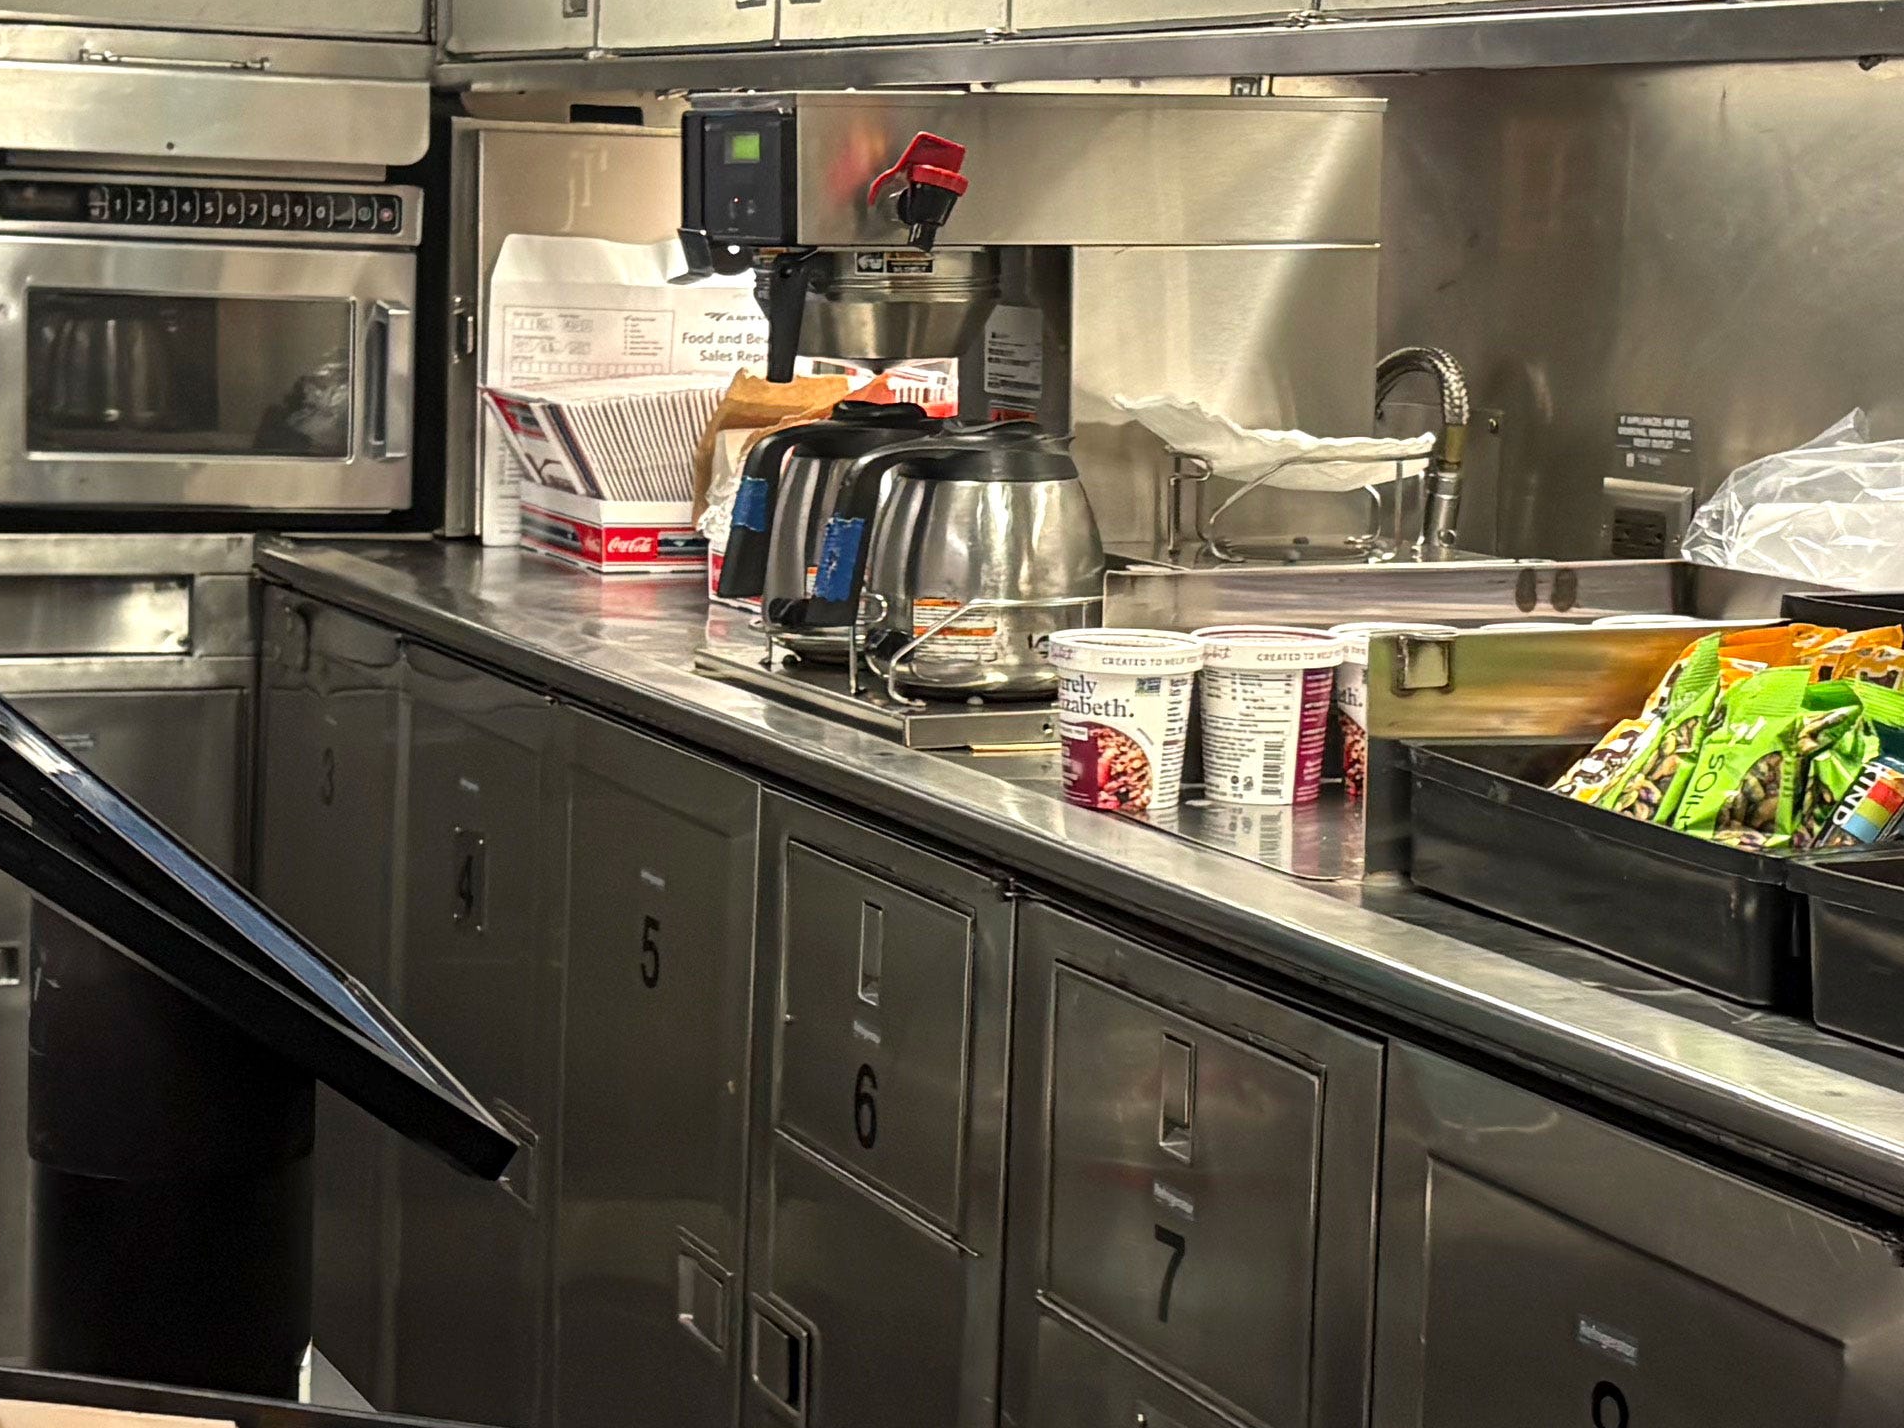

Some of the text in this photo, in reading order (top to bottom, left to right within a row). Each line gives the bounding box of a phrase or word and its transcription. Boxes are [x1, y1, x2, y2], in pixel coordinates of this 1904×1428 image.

[682, 332, 743, 345] Food and
[699, 351, 733, 362] Sales
[1102, 655, 1185, 667] CREATED TO HELP
[1257, 652, 1301, 663] CREATED
[1303, 652, 1316, 663] TO
[1058, 674, 1097, 698] urely
[1832, 760, 1884, 829] KIND
[456, 854, 476, 916] 4
[640, 917, 661, 989] 5
[853, 1063, 879, 1149] 6
[1153, 1225, 1185, 1322] 7
